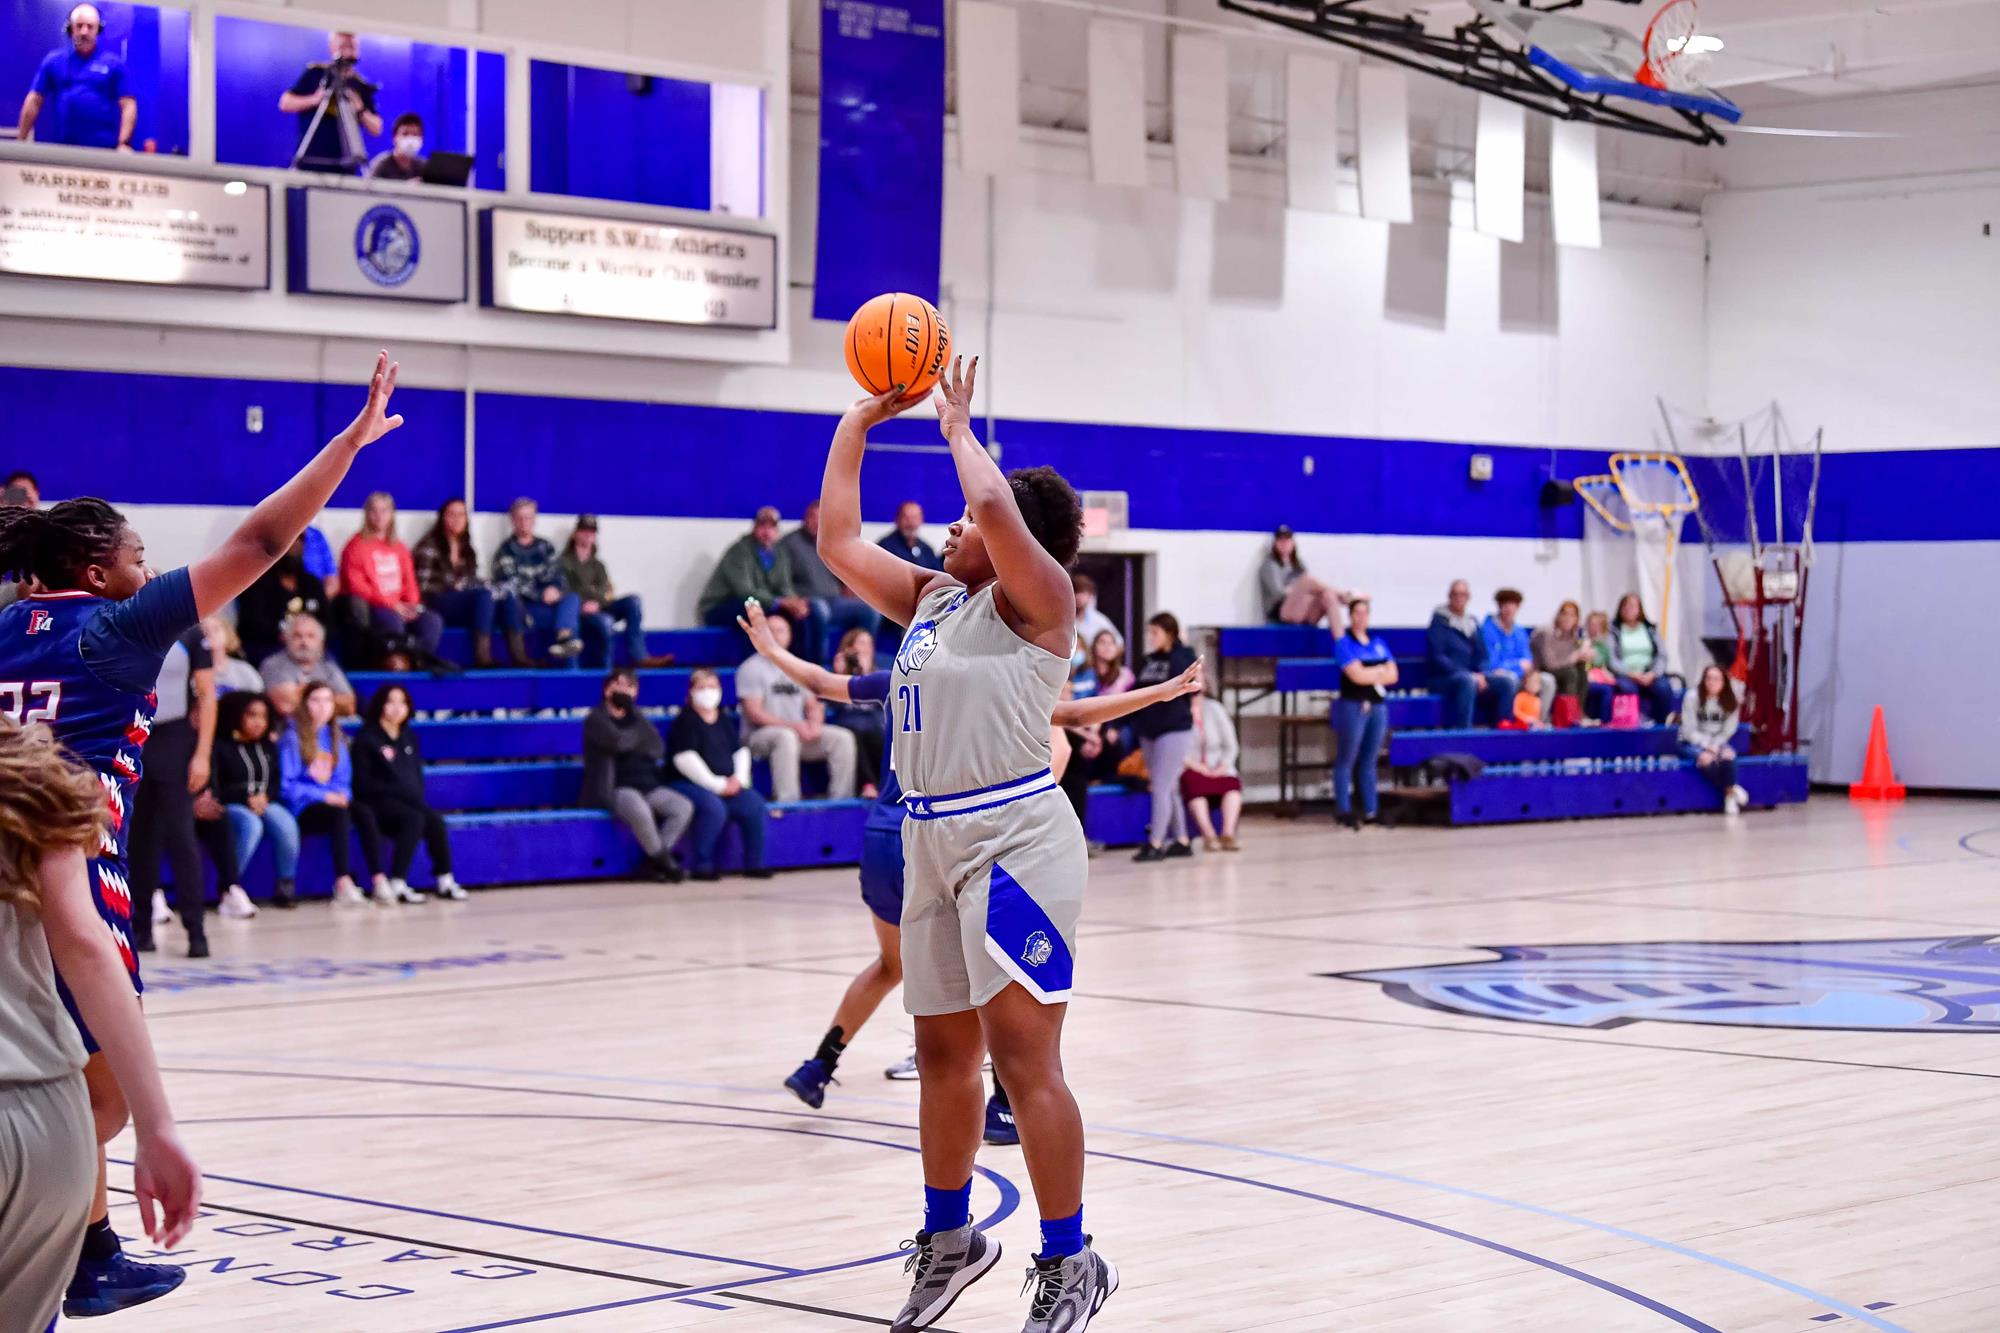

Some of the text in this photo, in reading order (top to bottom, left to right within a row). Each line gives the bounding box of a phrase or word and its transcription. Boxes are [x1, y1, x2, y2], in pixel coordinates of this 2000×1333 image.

[525, 219, 596, 247] Support
[670, 235, 747, 259] Athletics
[898, 683, 923, 734] 21
